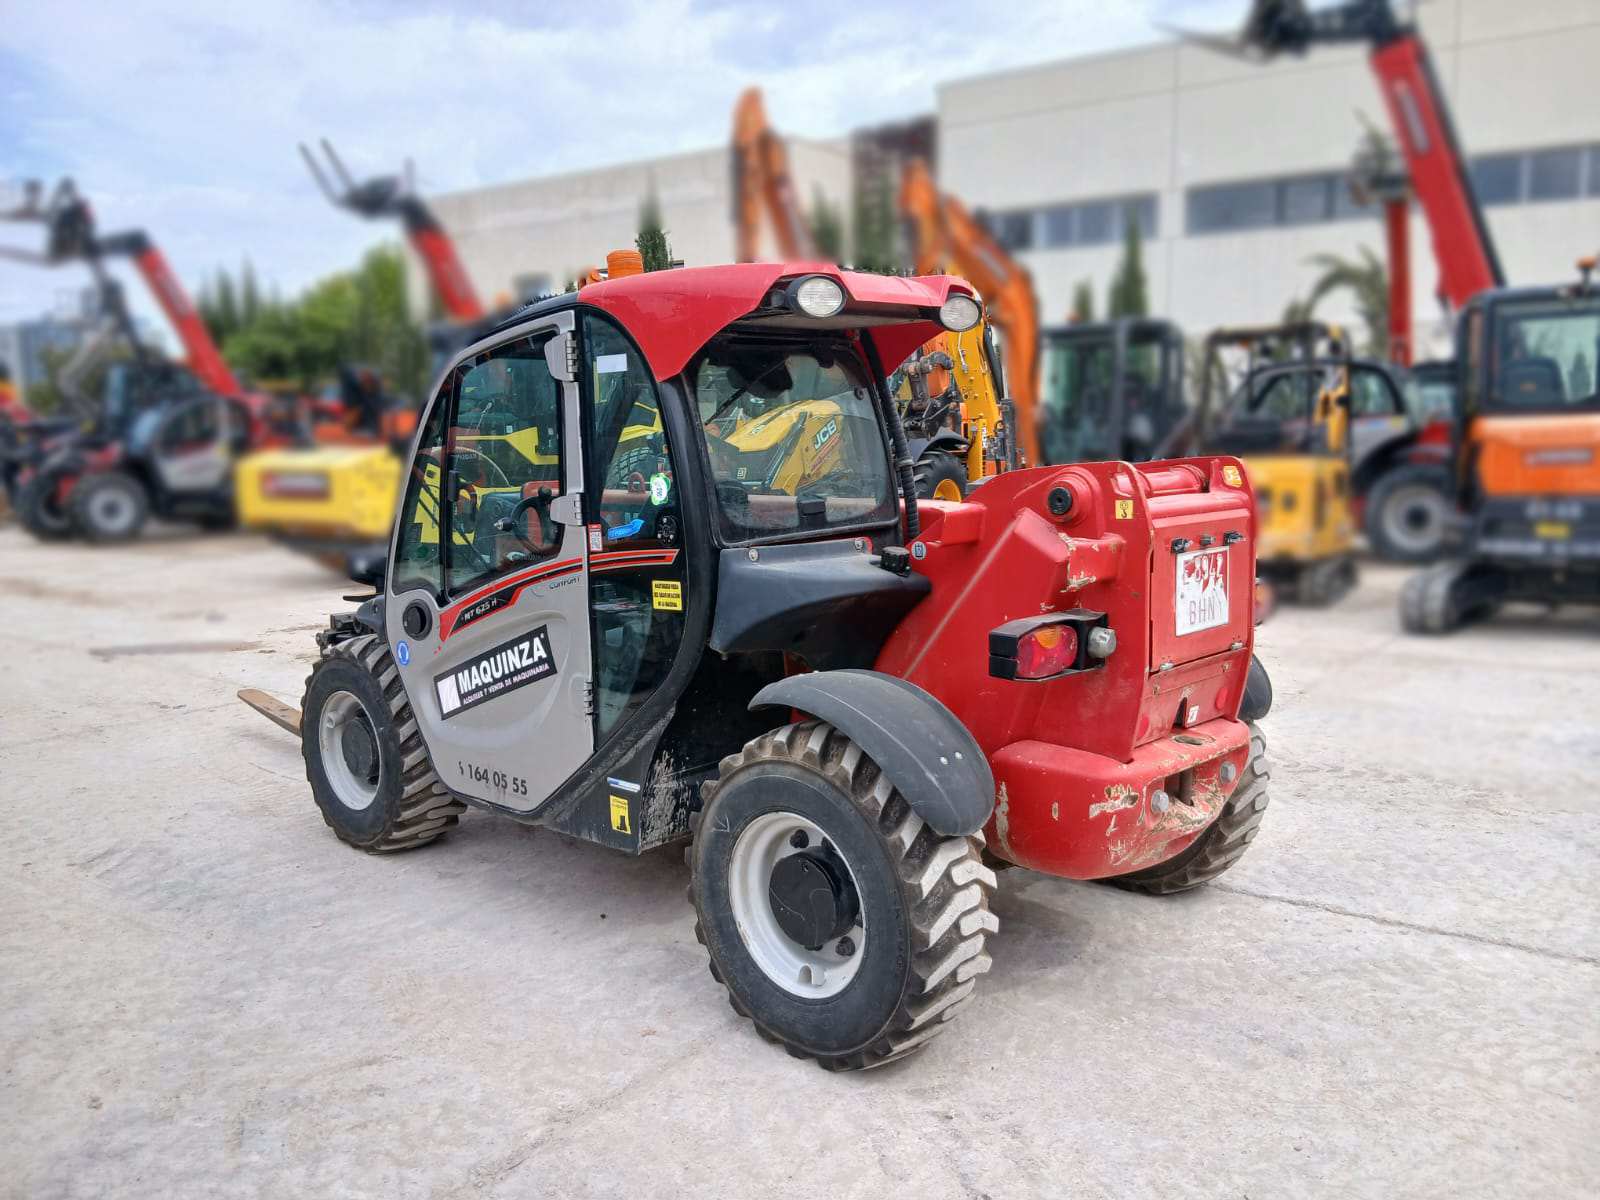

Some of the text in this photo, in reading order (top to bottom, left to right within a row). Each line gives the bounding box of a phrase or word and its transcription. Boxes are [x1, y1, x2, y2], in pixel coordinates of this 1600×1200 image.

[814, 419, 837, 450] JCB
[464, 597, 498, 621] MT 625 H
[458, 637, 547, 694] MAQUINZA
[468, 764, 489, 784] 164
[493, 771, 508, 790] 05
[512, 776, 528, 796] 55
